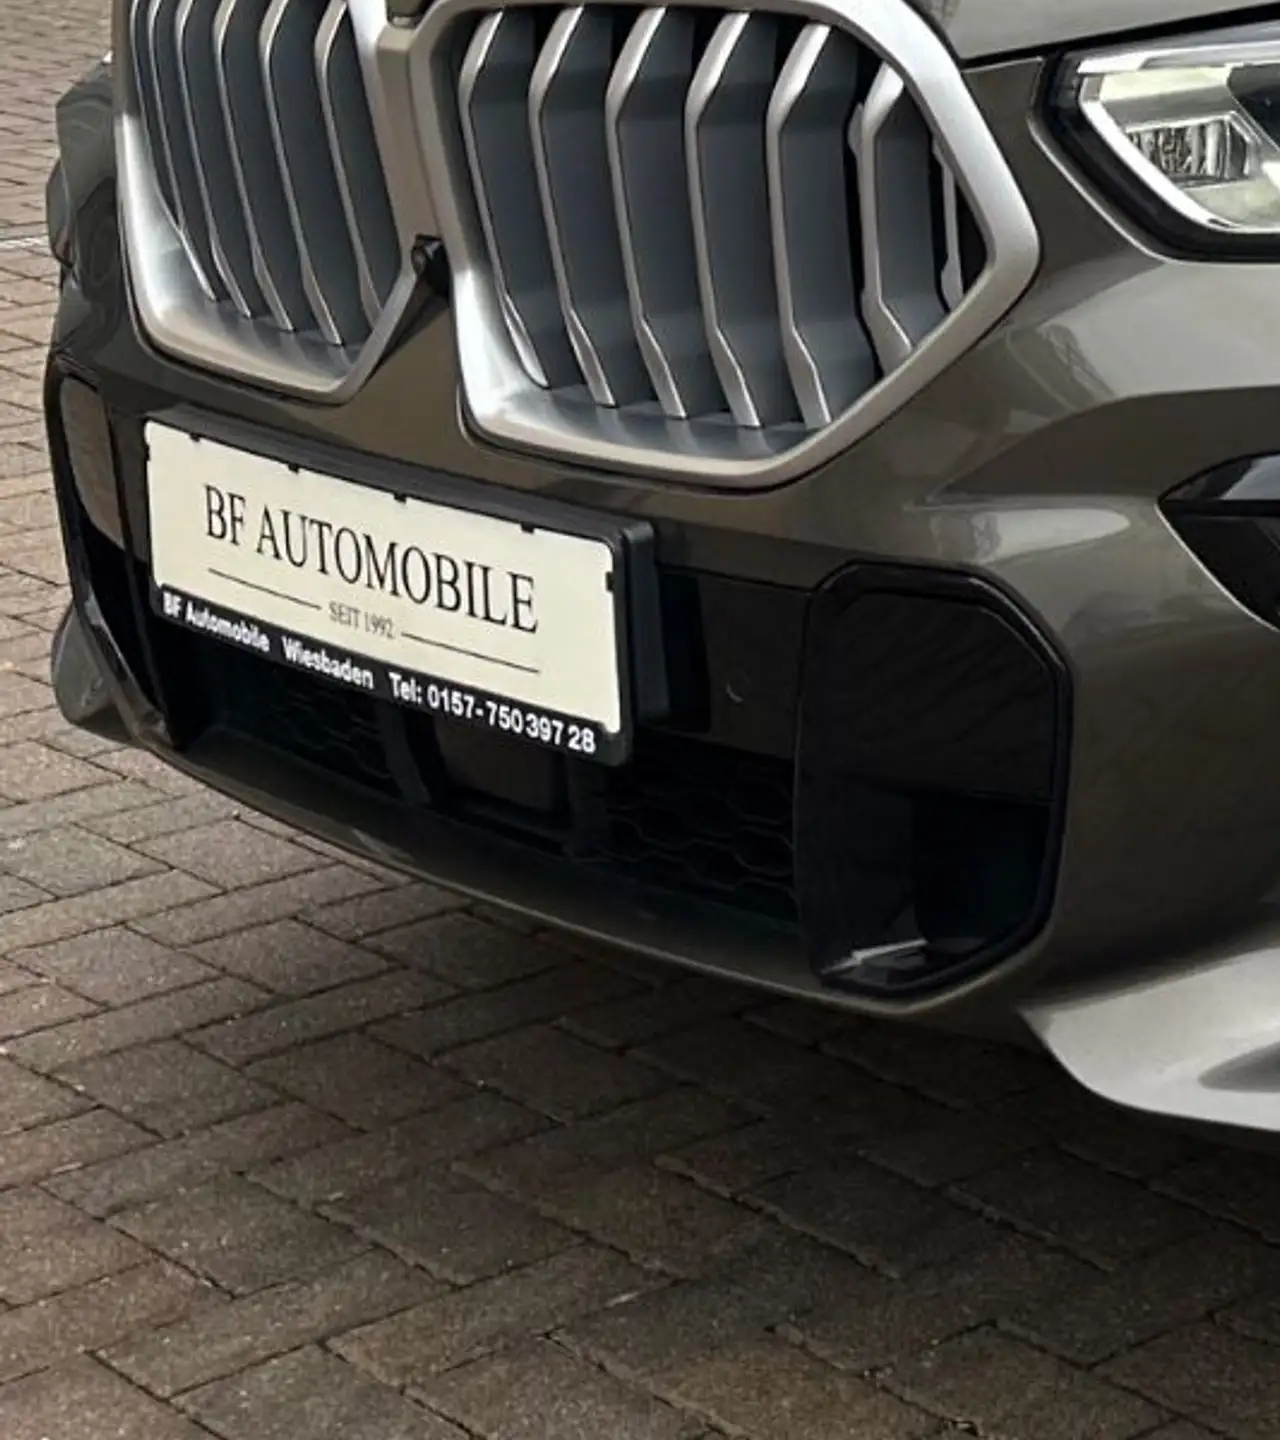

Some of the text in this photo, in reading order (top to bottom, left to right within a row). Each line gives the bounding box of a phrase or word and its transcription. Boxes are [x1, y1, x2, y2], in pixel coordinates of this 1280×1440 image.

[204, 483, 539, 635] BF AUTOMOBILE
[186, 601, 271, 652] Automobile
[281, 635, 375, 690] Wiesbaden
[388, 671, 423, 704] Tel:
[328, 600, 361, 630] SEIT
